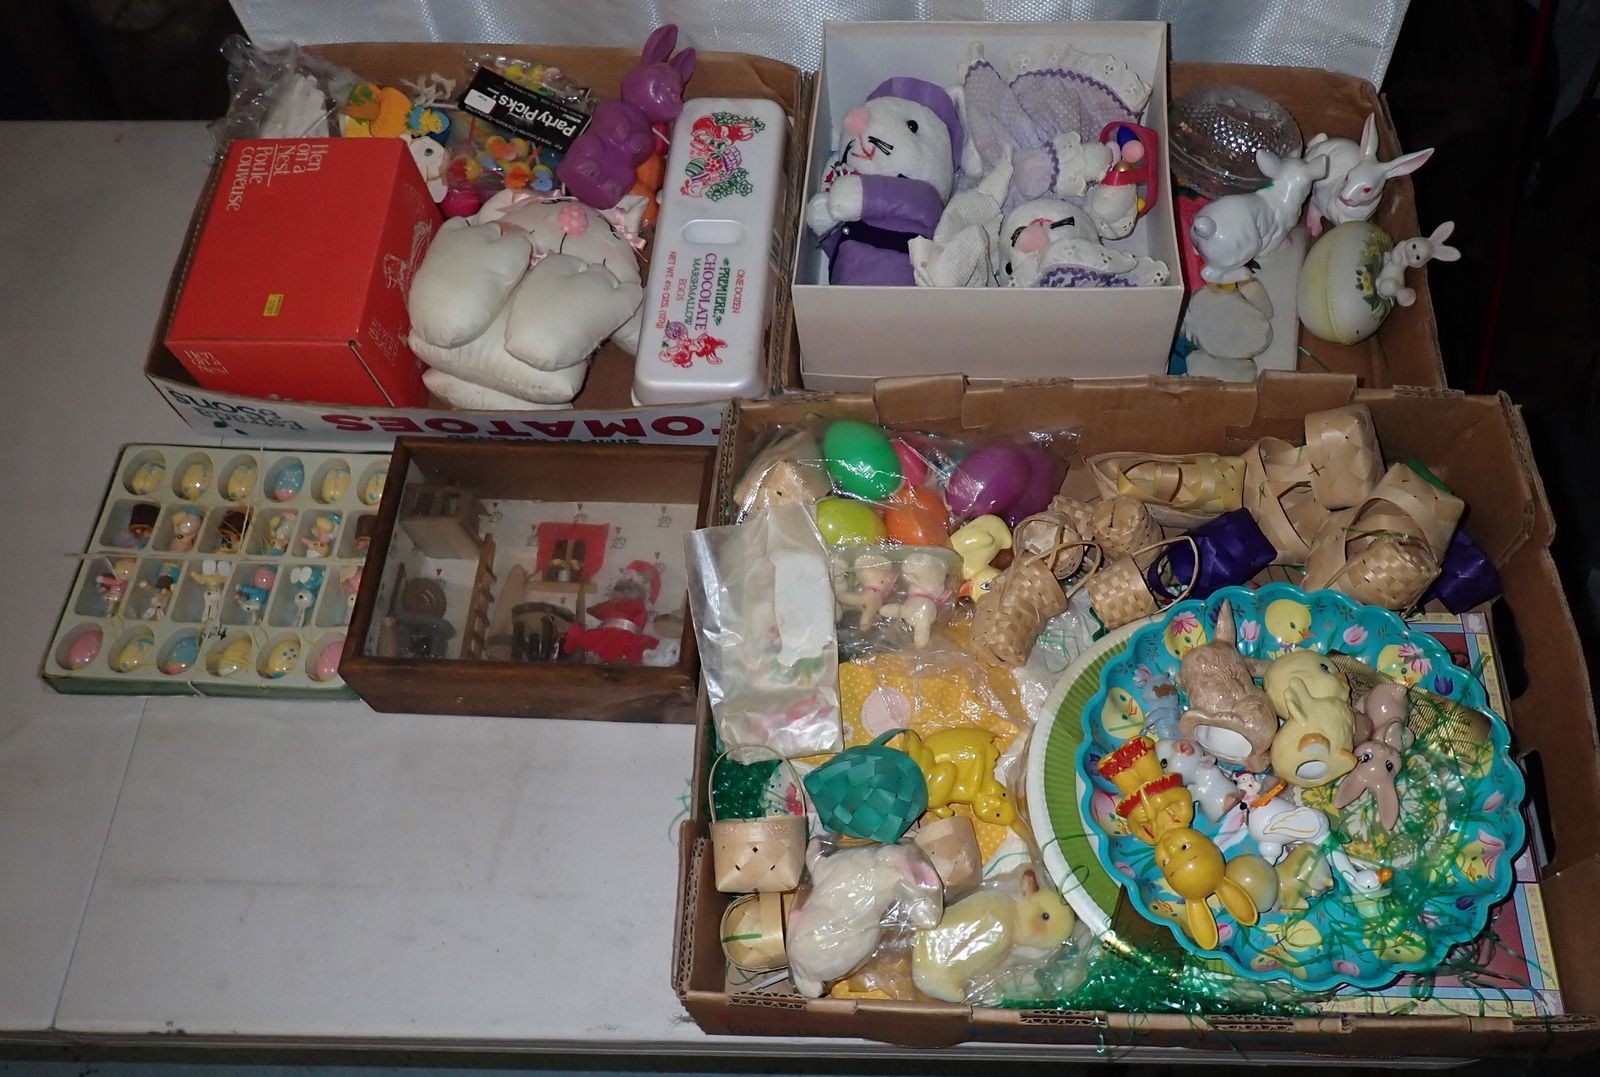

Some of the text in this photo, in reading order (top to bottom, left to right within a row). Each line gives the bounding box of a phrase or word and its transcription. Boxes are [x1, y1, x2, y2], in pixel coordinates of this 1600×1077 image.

[498, 94, 539, 122] Picks
[538, 109, 577, 137] Party
[249, 146, 274, 184] Poule
[273, 145, 297, 176] Nest
[293, 143, 311, 174] on a
[307, 144, 329, 171] Hen
[226, 146, 256, 212] couveuse
[667, 250, 677, 265] NET
[676, 278, 688, 302] EGGS
[684, 257, 702, 326] MARSHMALLOW
[694, 252, 718, 331] CHOCOLATE
[732, 269, 746, 314] ONE DOZEN
[321, 414, 720, 438] OMATOES
